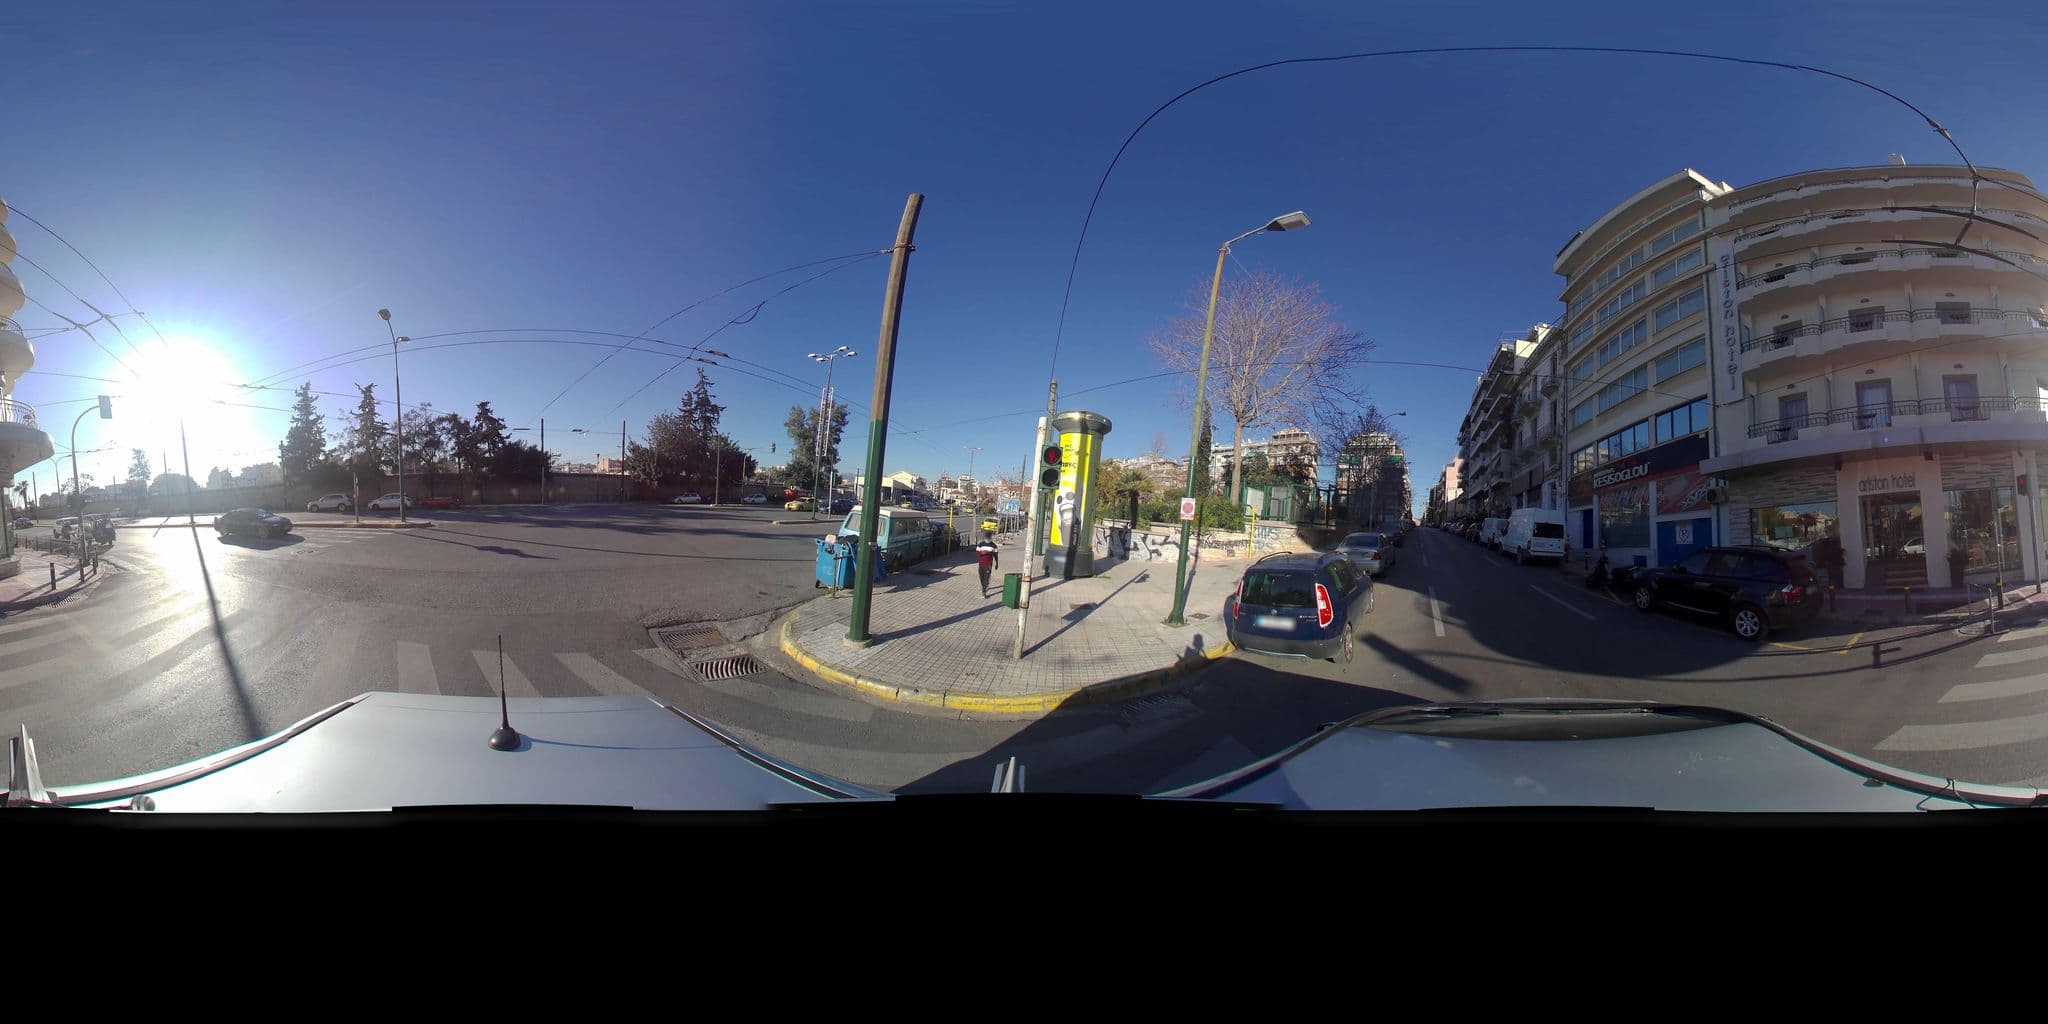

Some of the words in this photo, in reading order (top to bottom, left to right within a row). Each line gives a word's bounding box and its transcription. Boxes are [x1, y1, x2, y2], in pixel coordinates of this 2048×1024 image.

[1725, 325, 1738, 391] hotel
[1593, 464, 1649, 489] KESISOGLOU
[1859, 474, 1889, 492] ariston
[1891, 472, 1916, 489] hotel
